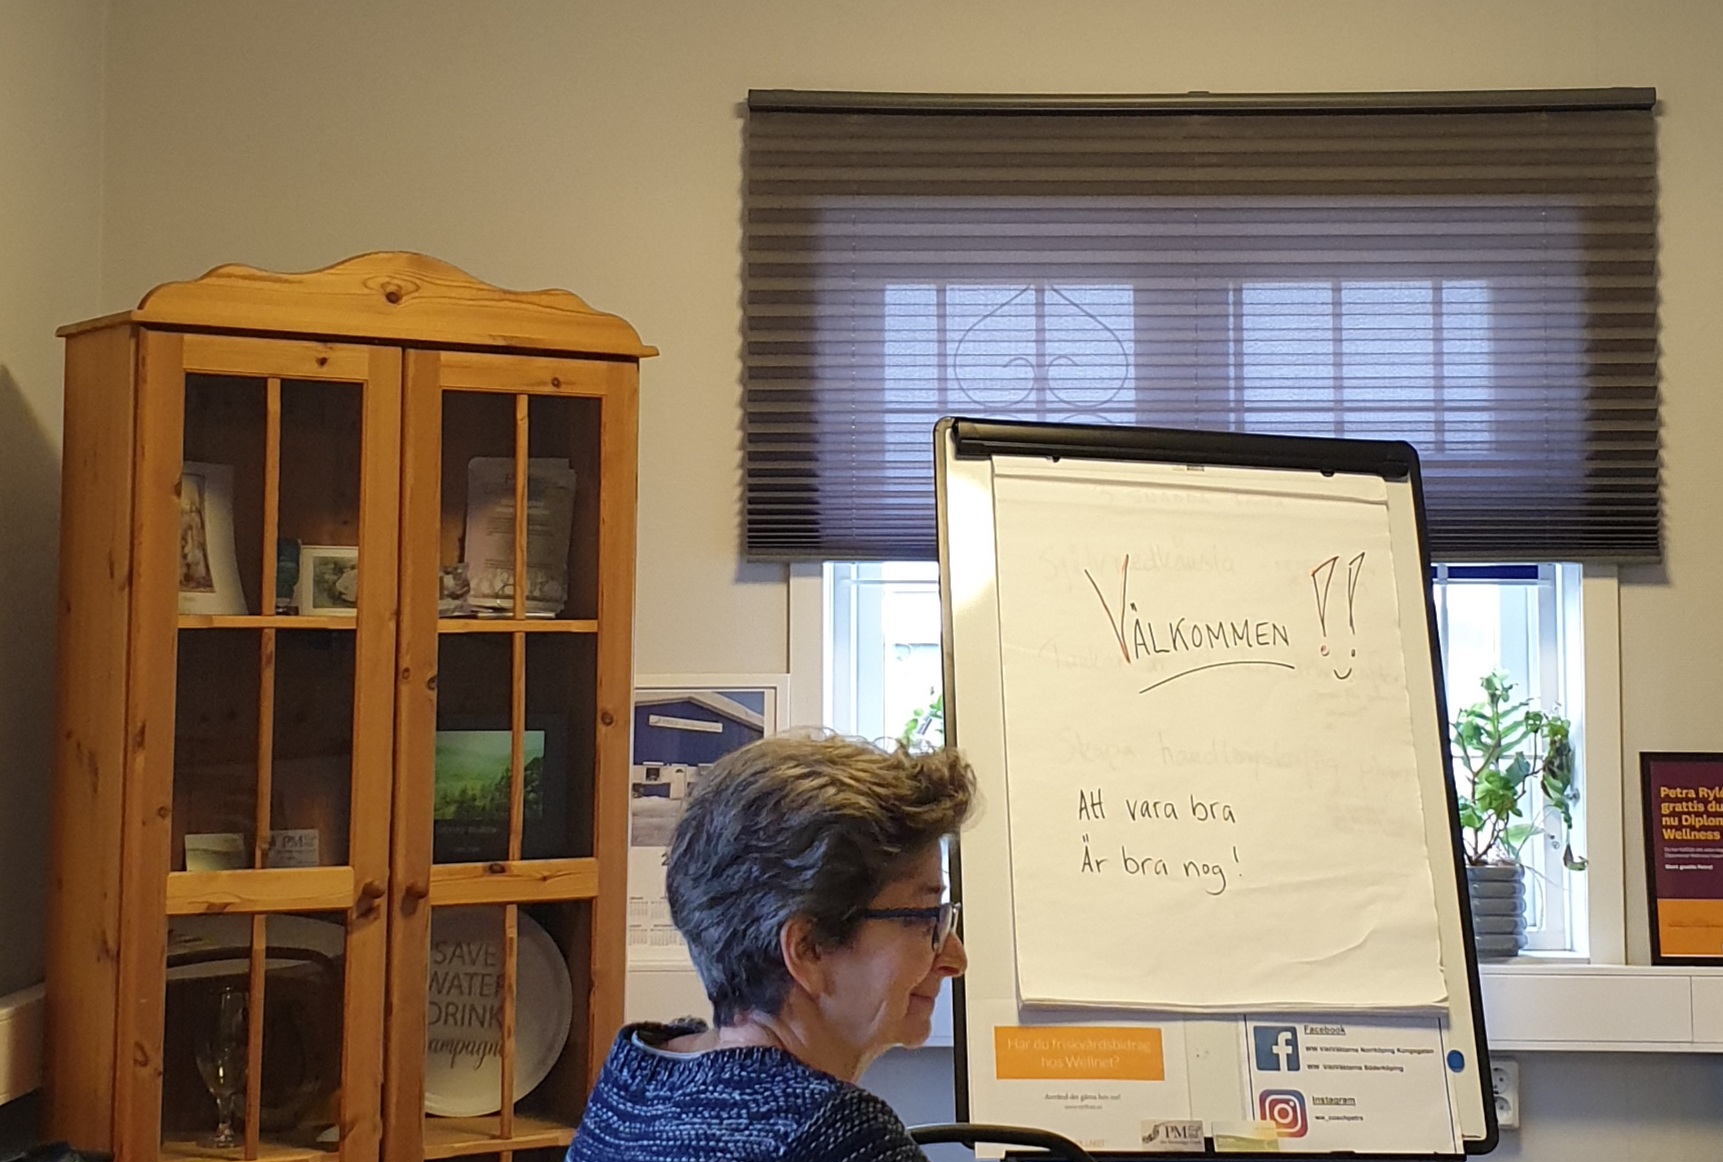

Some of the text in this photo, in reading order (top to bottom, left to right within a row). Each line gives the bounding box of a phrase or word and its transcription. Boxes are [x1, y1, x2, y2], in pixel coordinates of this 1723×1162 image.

[1084, 554, 1289, 664] VÄLKOMMEN
[1660, 787, 1696, 798] Petra
[1079, 788, 1236, 823] Att vara bra
[1661, 801, 1704, 814] grattis
[1662, 816, 1678, 826] nu
[1662, 828, 1720, 840] Wellness
[1082, 834, 1108, 873] Är
[1122, 846, 1168, 875] bra
[434, 942, 497, 967] SAVE
[1304, 1026, 1346, 1035] Facebook
[1007, 1037, 1151, 1053] Har du friskvårdsbidrag
[1041, 1056, 1120, 1068] hos Wellnet?
[1312, 1096, 1356, 1105] Instagram
[1165, 1125, 1187, 1139] PM
